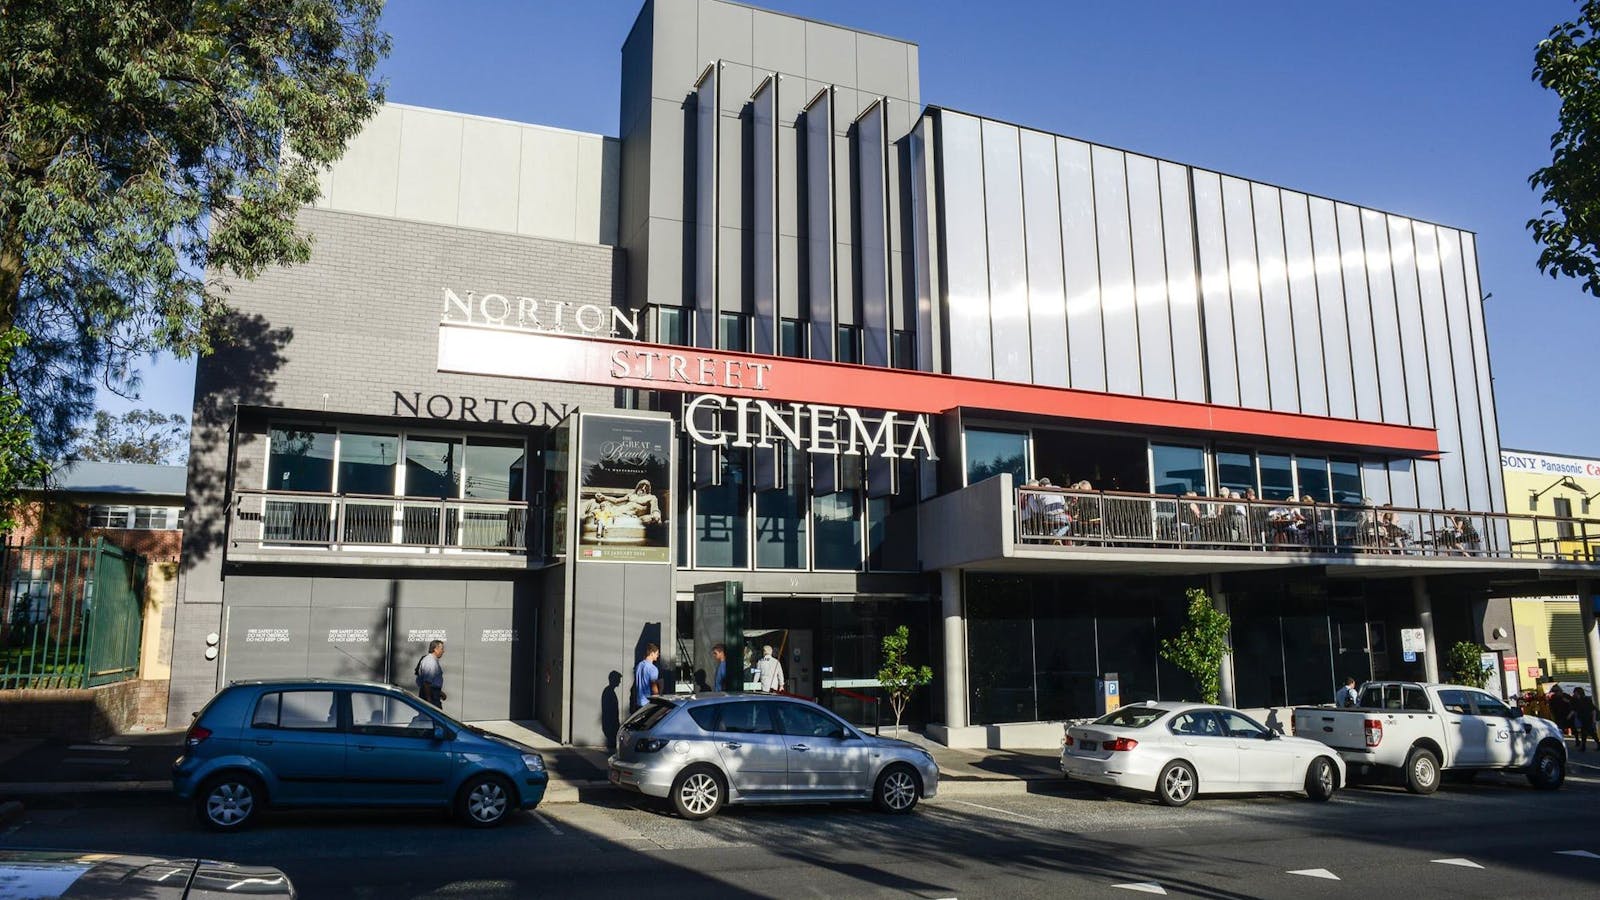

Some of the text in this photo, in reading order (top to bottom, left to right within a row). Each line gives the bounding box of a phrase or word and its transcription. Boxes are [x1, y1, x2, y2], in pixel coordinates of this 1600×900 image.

[441, 287, 640, 341] NORTON
[610, 349, 772, 391] STREET
[392, 390, 568, 427] NORTON
[685, 394, 939, 461] CINEMA
[600, 441, 651, 466] Beauty
[622, 441, 651, 449] GREAT
[1501, 456, 1536, 469] SONY
[1541, 460, 1583, 474] Panasonic
[1110, 684, 1116, 694] P
